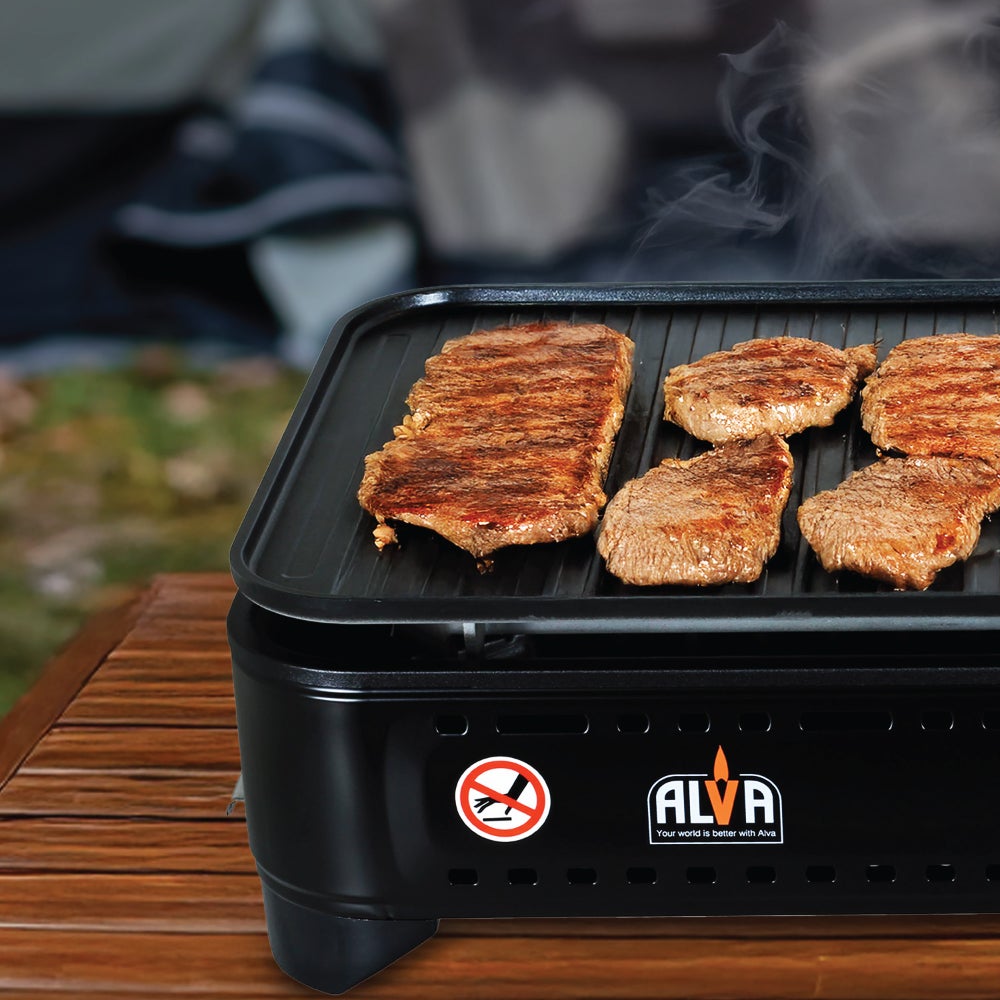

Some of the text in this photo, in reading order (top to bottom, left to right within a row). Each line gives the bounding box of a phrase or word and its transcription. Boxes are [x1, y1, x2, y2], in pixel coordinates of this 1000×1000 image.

[656, 780, 775, 825] ALVA
[656, 829, 776, 837] Your world is better with Alva
